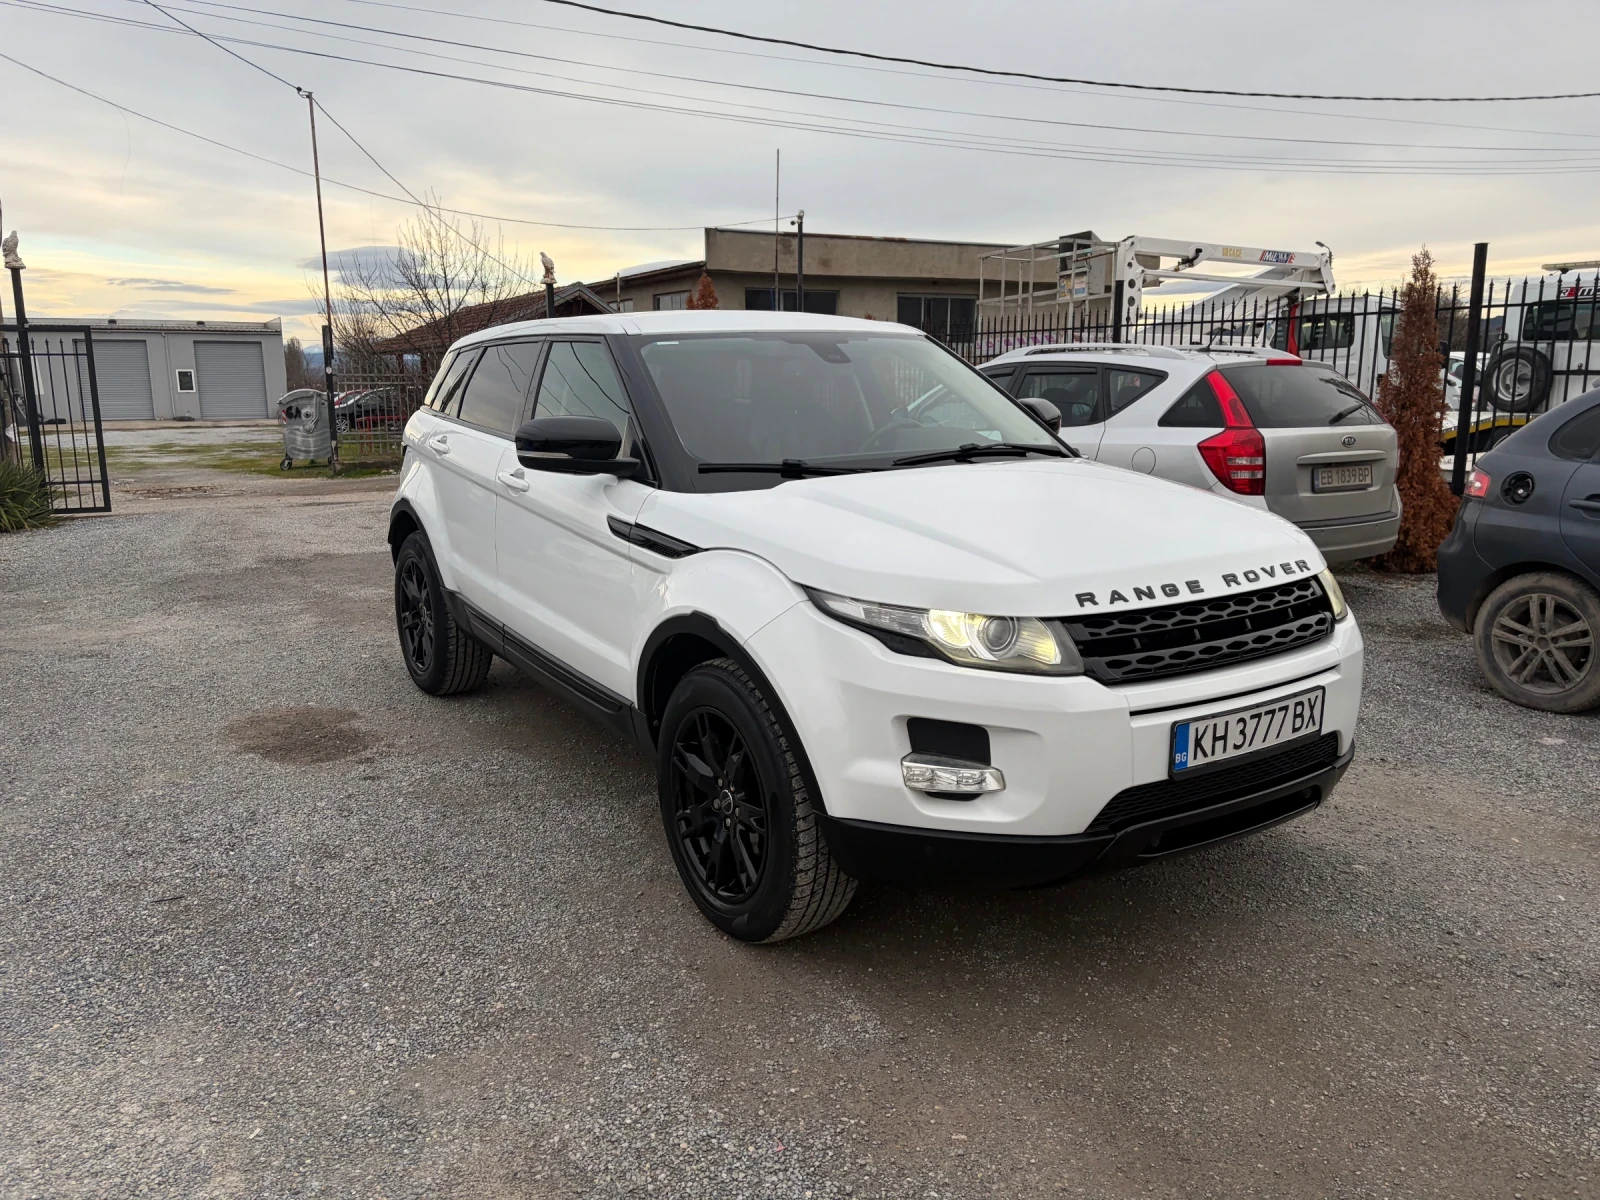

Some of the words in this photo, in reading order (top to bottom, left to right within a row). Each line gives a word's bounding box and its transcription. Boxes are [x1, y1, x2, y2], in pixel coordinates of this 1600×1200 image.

[1321, 470, 1333, 485] EB
[1336, 469, 1357, 484] 1839
[1358, 468, 1369, 482] BP
[1075, 580, 1205, 607] RANGE
[1221, 559, 1311, 588] ROVER
[1193, 720, 1229, 760] KH
[1233, 704, 1290, 750] 3777
[1292, 695, 1319, 734] BX
[1175, 753, 1187, 763] BG
